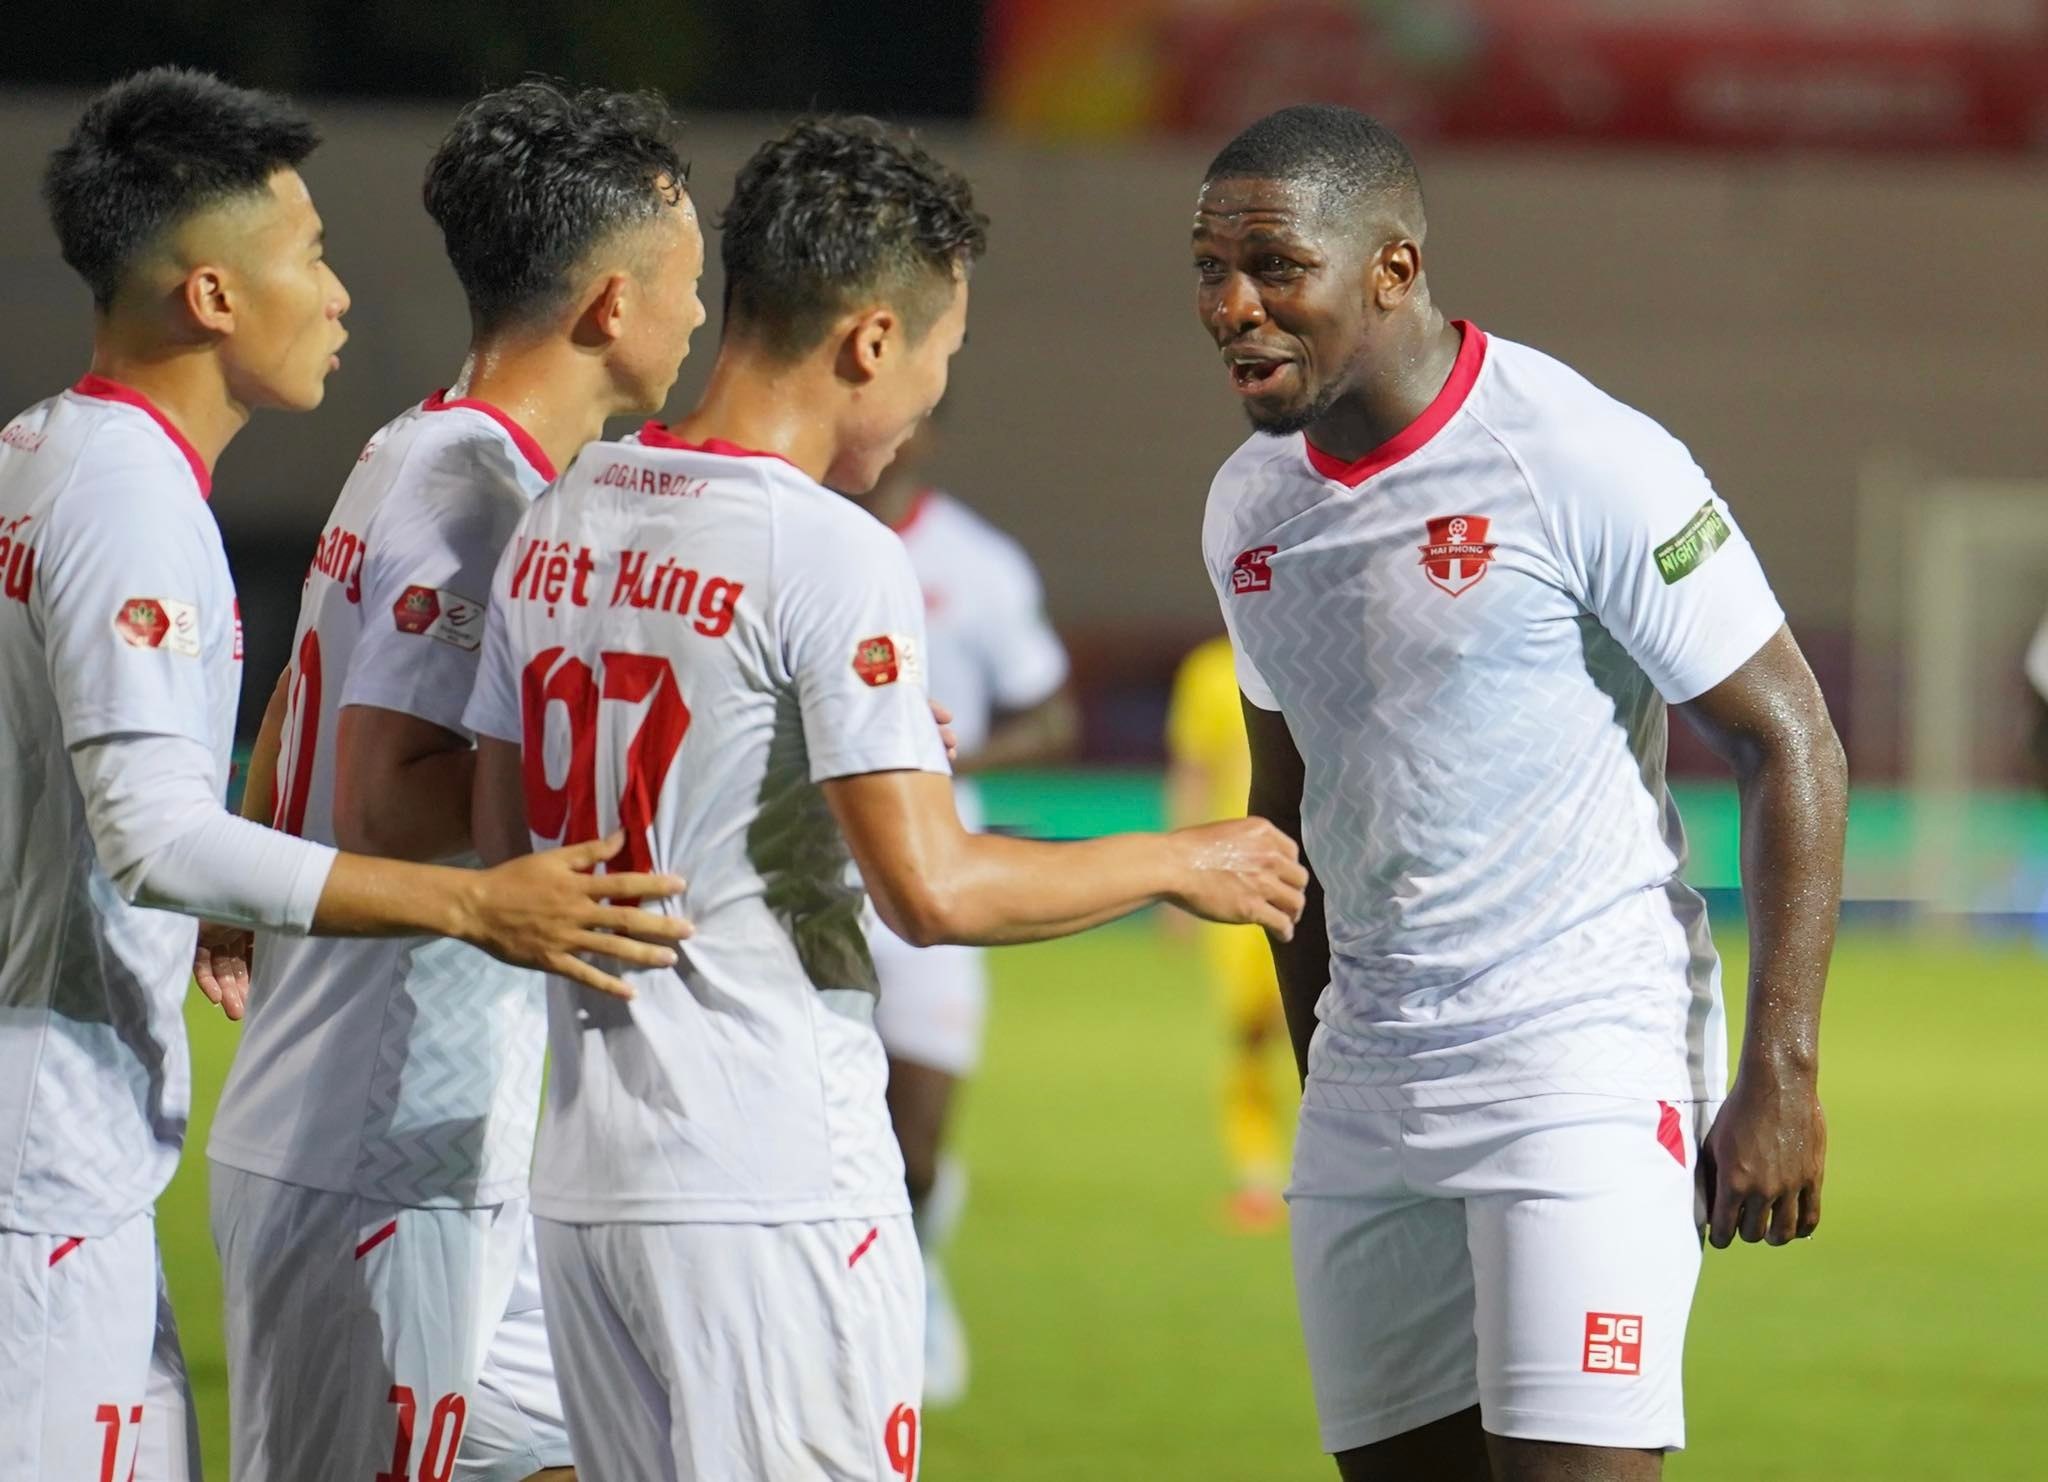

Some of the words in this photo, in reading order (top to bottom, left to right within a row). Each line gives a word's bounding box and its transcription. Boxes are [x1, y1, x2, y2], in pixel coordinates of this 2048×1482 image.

[593, 463, 709, 498] OGARBO
[0, 514, 36, 606] ếu
[1430, 546, 1447, 556] HAI
[1448, 545, 1484, 554] PHONG
[1659, 535, 1699, 575] NIGHT
[510, 536, 595, 619] Việt
[609, 550, 744, 638] Hưng
[1233, 569, 1267, 589] BL
[271, 626, 322, 838] 0
[521, 646, 692, 907] 97
[1589, 1316, 1640, 1344] JG
[1587, 1343, 1638, 1371] BL
[374, 1384, 467, 1482] 10
